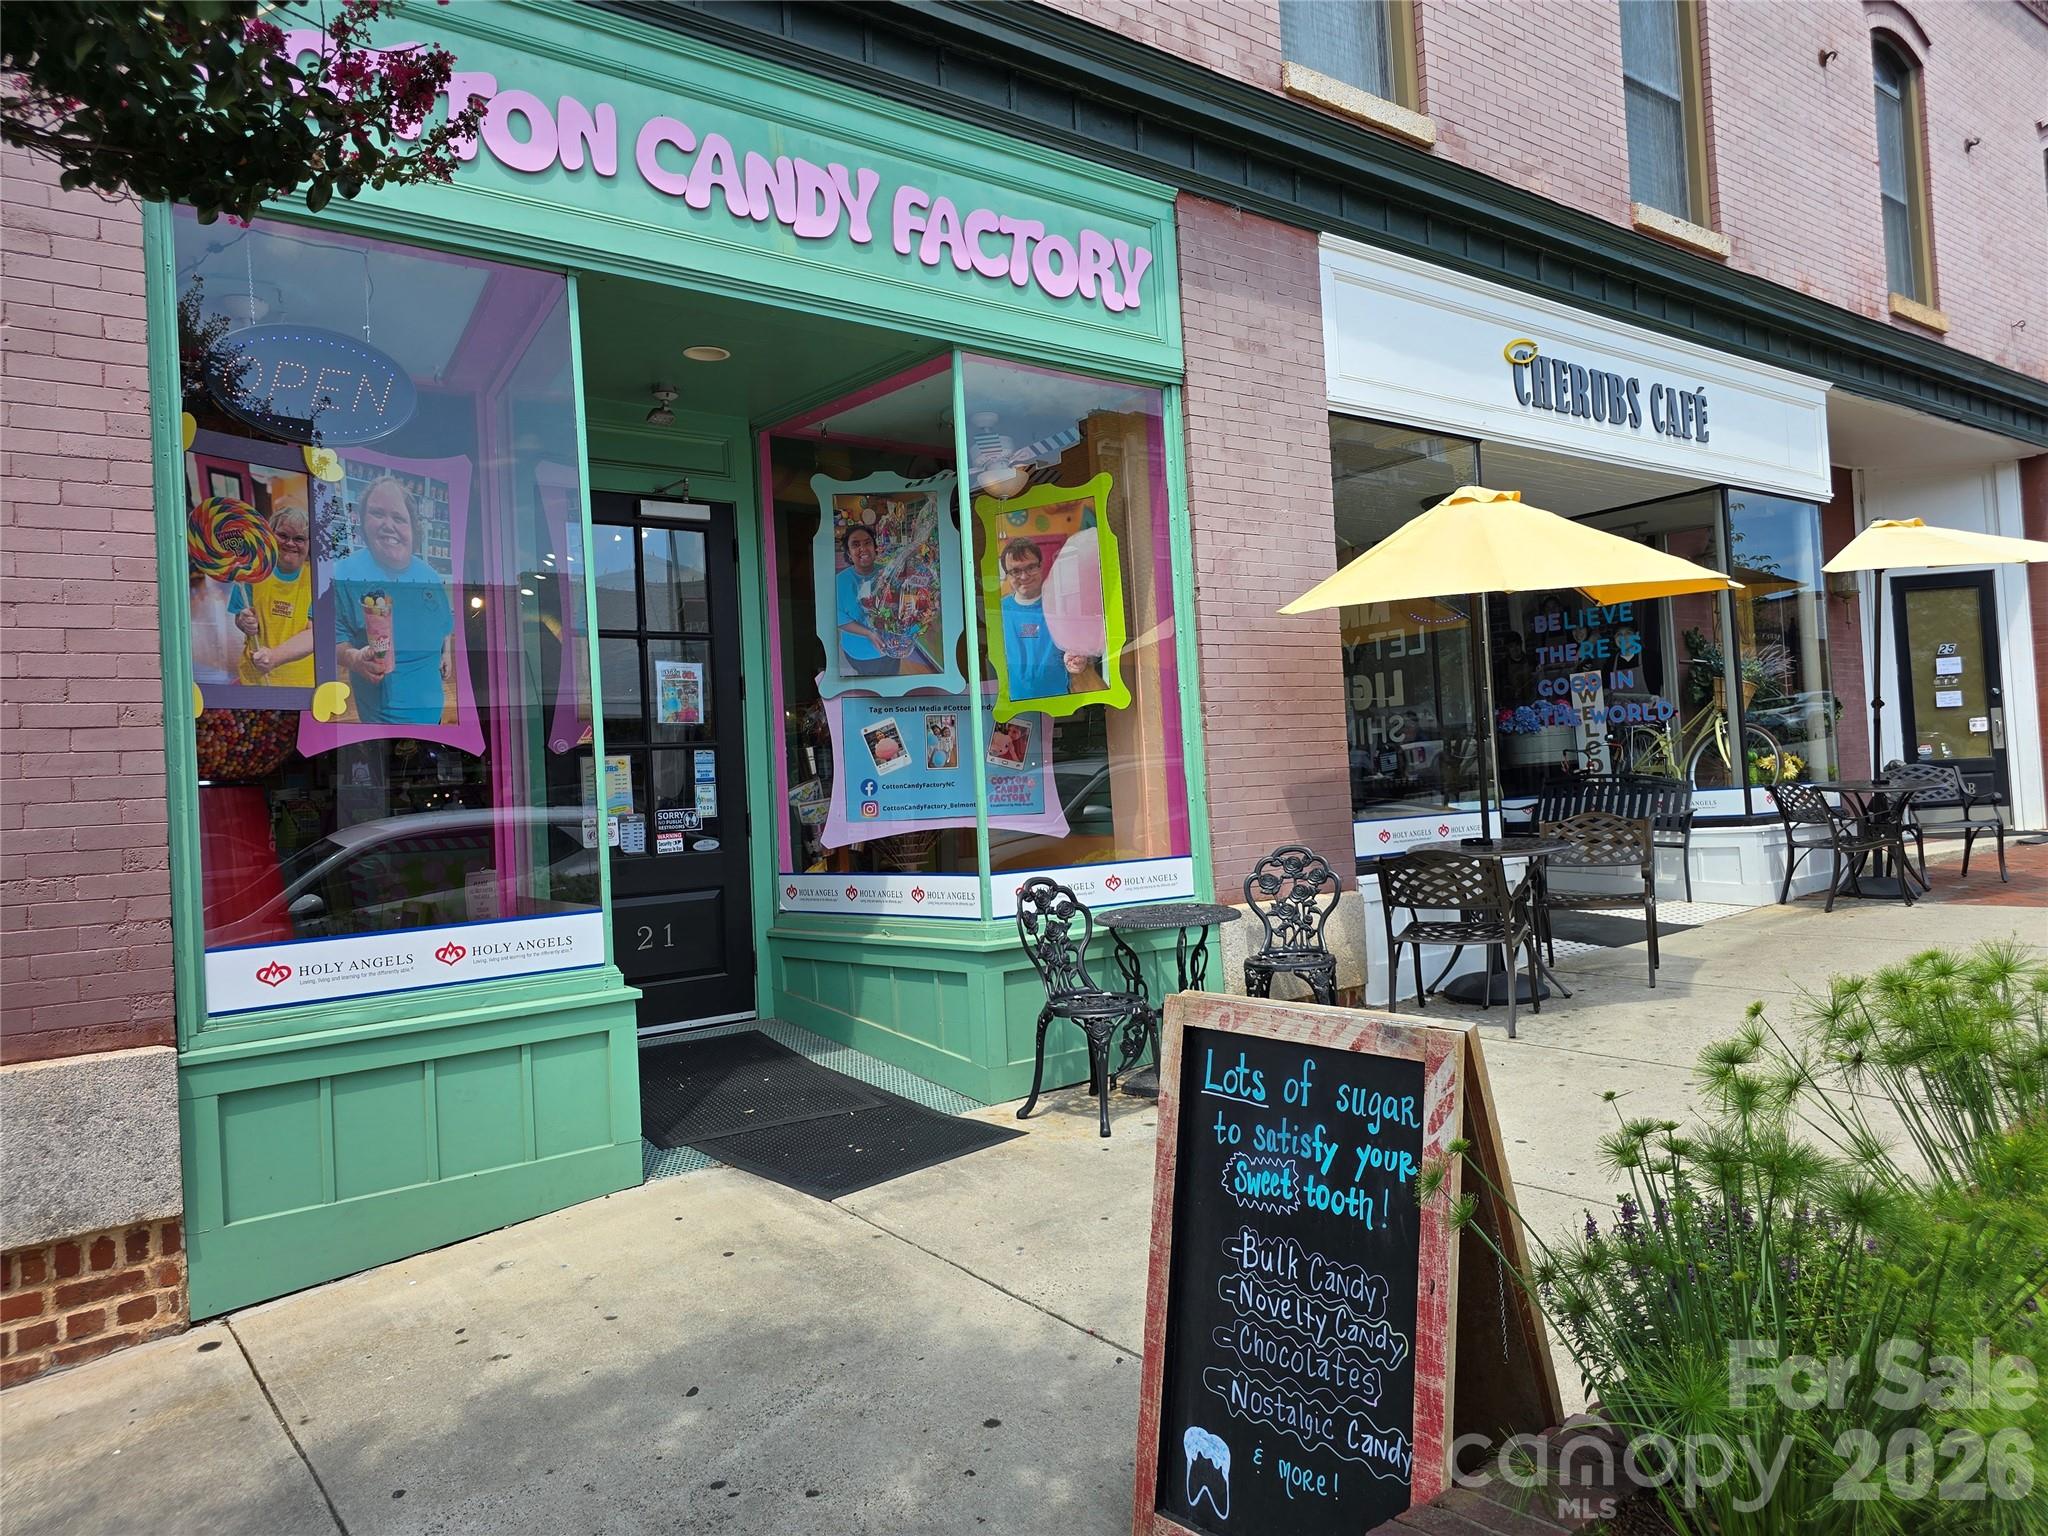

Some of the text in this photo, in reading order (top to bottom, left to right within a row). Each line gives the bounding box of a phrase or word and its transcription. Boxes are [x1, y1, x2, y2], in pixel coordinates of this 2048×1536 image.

[192, 18, 1153, 312] OTTON CANDY FACTORY
[224, 356, 394, 416] OPEN
[1513, 350, 1709, 443] CHERUBS CAFÉ
[1534, 602, 1634, 634] BELIEVE
[1535, 631, 1643, 665] THERE IS
[1939, 644, 1955, 654] 25
[1537, 670, 1634, 697] GOOD IN
[869, 706, 882, 714] Tag
[1541, 700, 1674, 729] THE WORLD
[882, 781, 956, 791] CottonCandyFactoryNC
[991, 775, 1028, 785] COTTON
[989, 792, 1032, 802] FACTORY
[882, 802, 977, 812] CottonCandyFactory_Belmont
[657, 811, 685, 820] SORRY
[1393, 829, 1432, 839] HOLY ANGELS
[1450, 824, 1481, 833] HOLY ANGE
[1067, 881, 1095, 891] NGELS
[1124, 873, 1178, 886] HOLY ANGELS
[799, 888, 839, 897] HOLY ANGELS
[859, 889, 903, 898] HOLY ANGELS
[927, 891, 976, 900] HOLY ANGELS
[636, 923, 675, 951] 21
[472, 936, 573, 956] HOLY ANGELS
[299, 953, 414, 977] HOLY ANGELS
[1204, 1048, 1267, 1101] Lots
[1283, 1058, 1316, 1107] of
[1213, 1110, 1241, 1145] to
[1253, 1117, 1339, 1176] satisfy
[1234, 1160, 1293, 1201] Sweet
